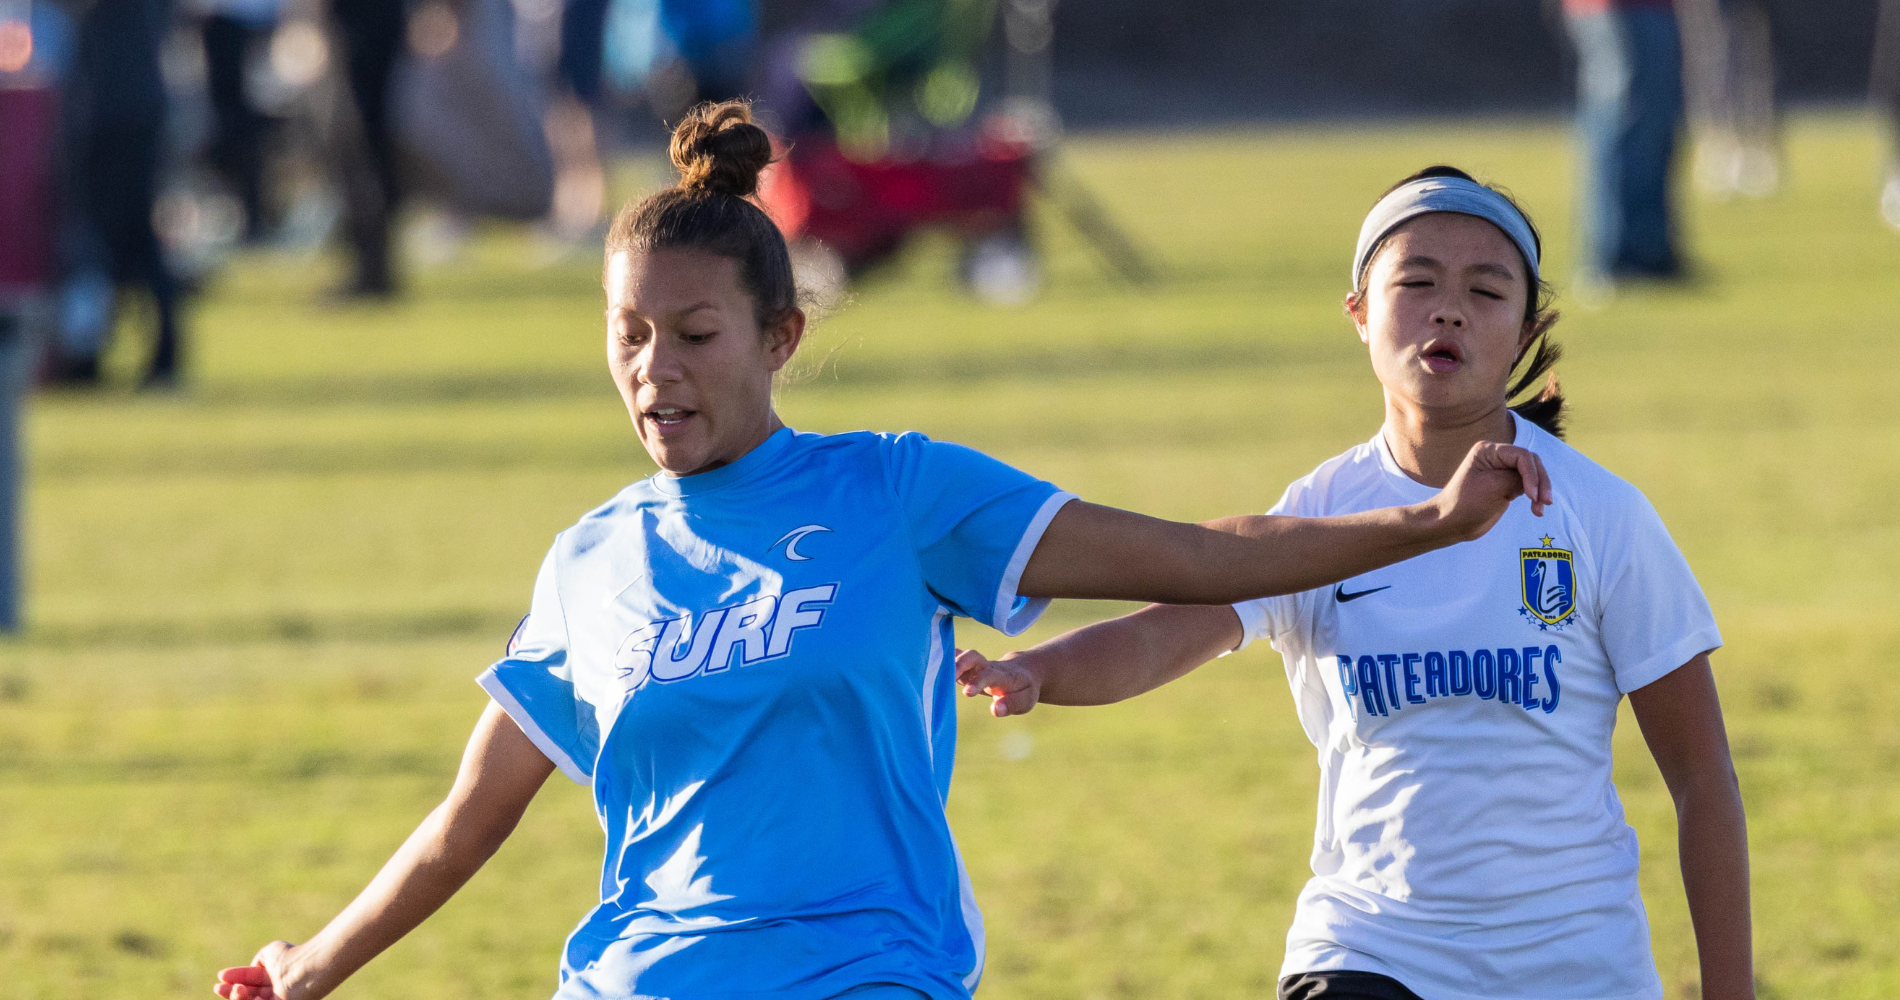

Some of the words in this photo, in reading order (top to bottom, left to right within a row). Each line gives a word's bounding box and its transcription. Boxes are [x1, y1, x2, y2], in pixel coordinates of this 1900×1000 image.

[1522, 551, 1570, 560] PATEADORES
[615, 581, 841, 694] SURF
[1336, 645, 1561, 723] PATEADORES
